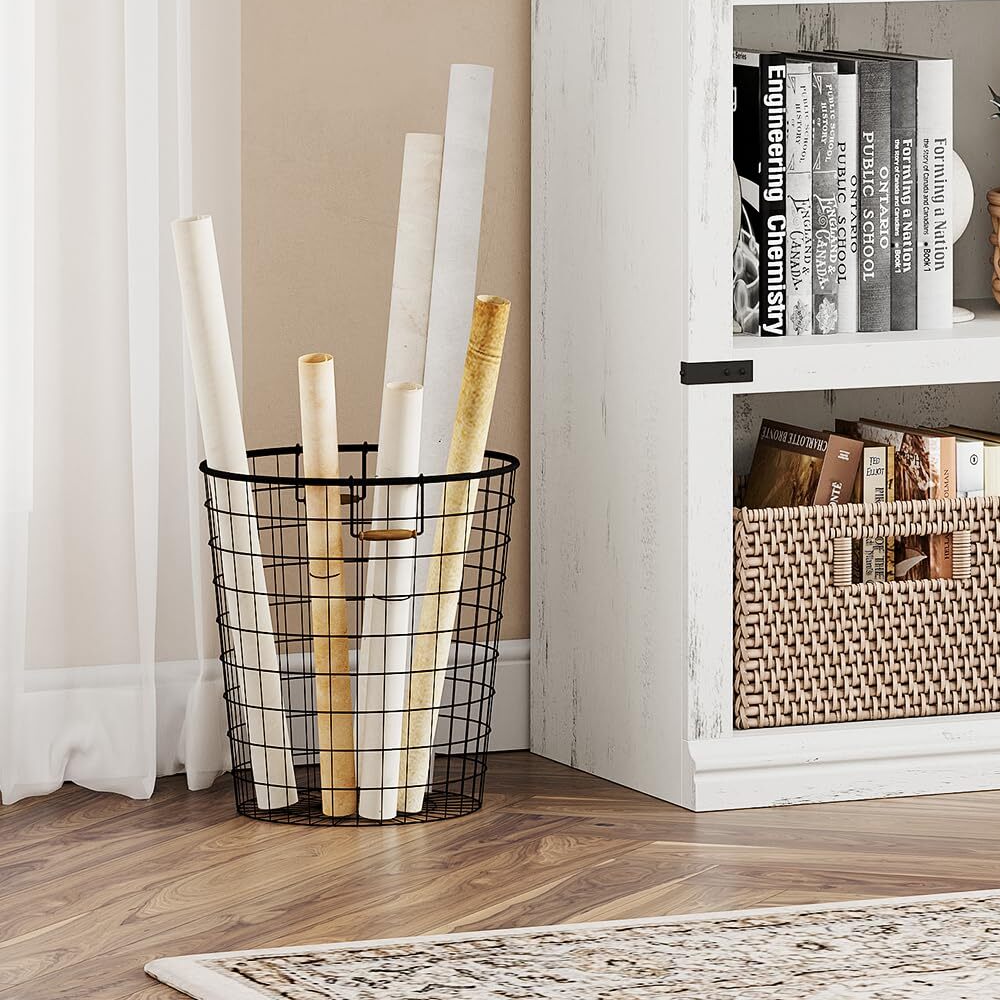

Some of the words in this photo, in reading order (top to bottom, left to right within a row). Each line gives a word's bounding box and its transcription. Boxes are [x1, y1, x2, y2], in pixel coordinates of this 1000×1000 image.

[800, 84, 810, 120] PUBLIC
[825, 83, 835, 120] PUBLIC
[764, 64, 786, 202] Engineering
[799, 123, 810, 164] SCHOOL
[825, 122, 836, 163] SCHOOL
[837, 142, 846, 204] PUBLIC
[862, 130, 874, 197] PUBLIC
[894, 165, 900, 173] of
[900, 138, 913, 205] Forming
[931, 138, 947, 204] Forming
[788, 194, 812, 264] ENGLAND
[814, 194, 837, 263] ENGLAND
[878, 165, 889, 249] ONTARIO
[902, 208, 911, 218] a
[934, 208, 945, 217] a
[837, 215, 846, 284] SCHOOL
[862, 208, 875, 282] SCHOOL
[902, 221, 913, 273] Nation
[923, 248, 931, 266] Book
[933, 220, 947, 272] Nation
[763, 214, 786, 335] Chemistry
[787, 432, 828, 452] CHARLOTTE
[869, 456, 881, 466] TED
[873, 536, 885, 553] OF
[874, 557, 884, 580] THE
